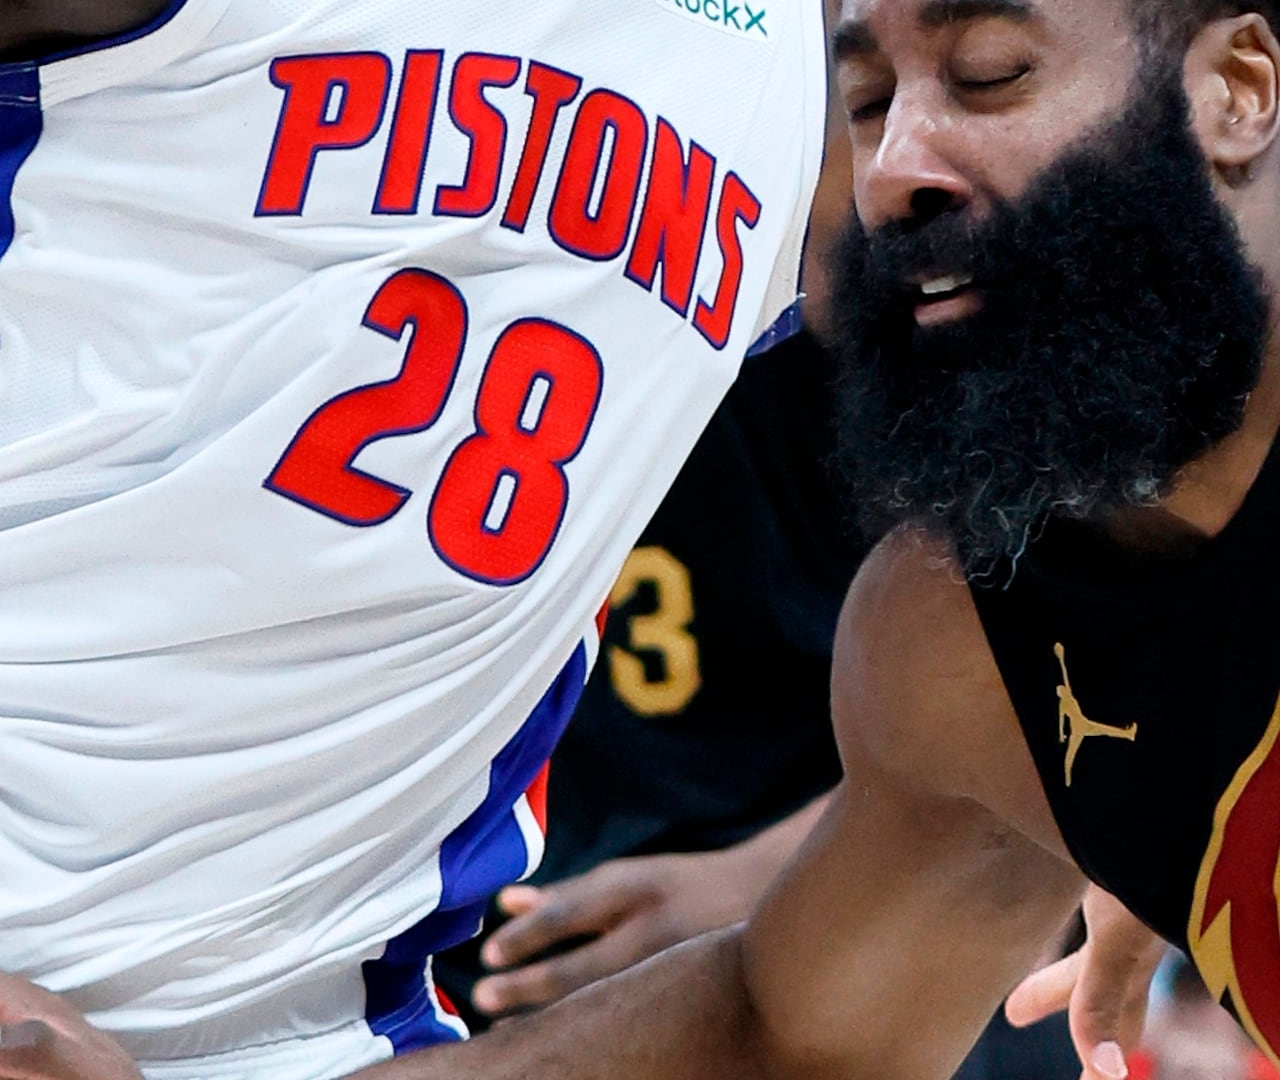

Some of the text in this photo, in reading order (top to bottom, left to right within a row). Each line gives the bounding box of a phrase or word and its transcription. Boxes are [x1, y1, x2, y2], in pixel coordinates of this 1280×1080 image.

[254, 48, 762, 351] PISTONS
[263, 266, 604, 587] 28
[609, 545, 702, 717] 3
